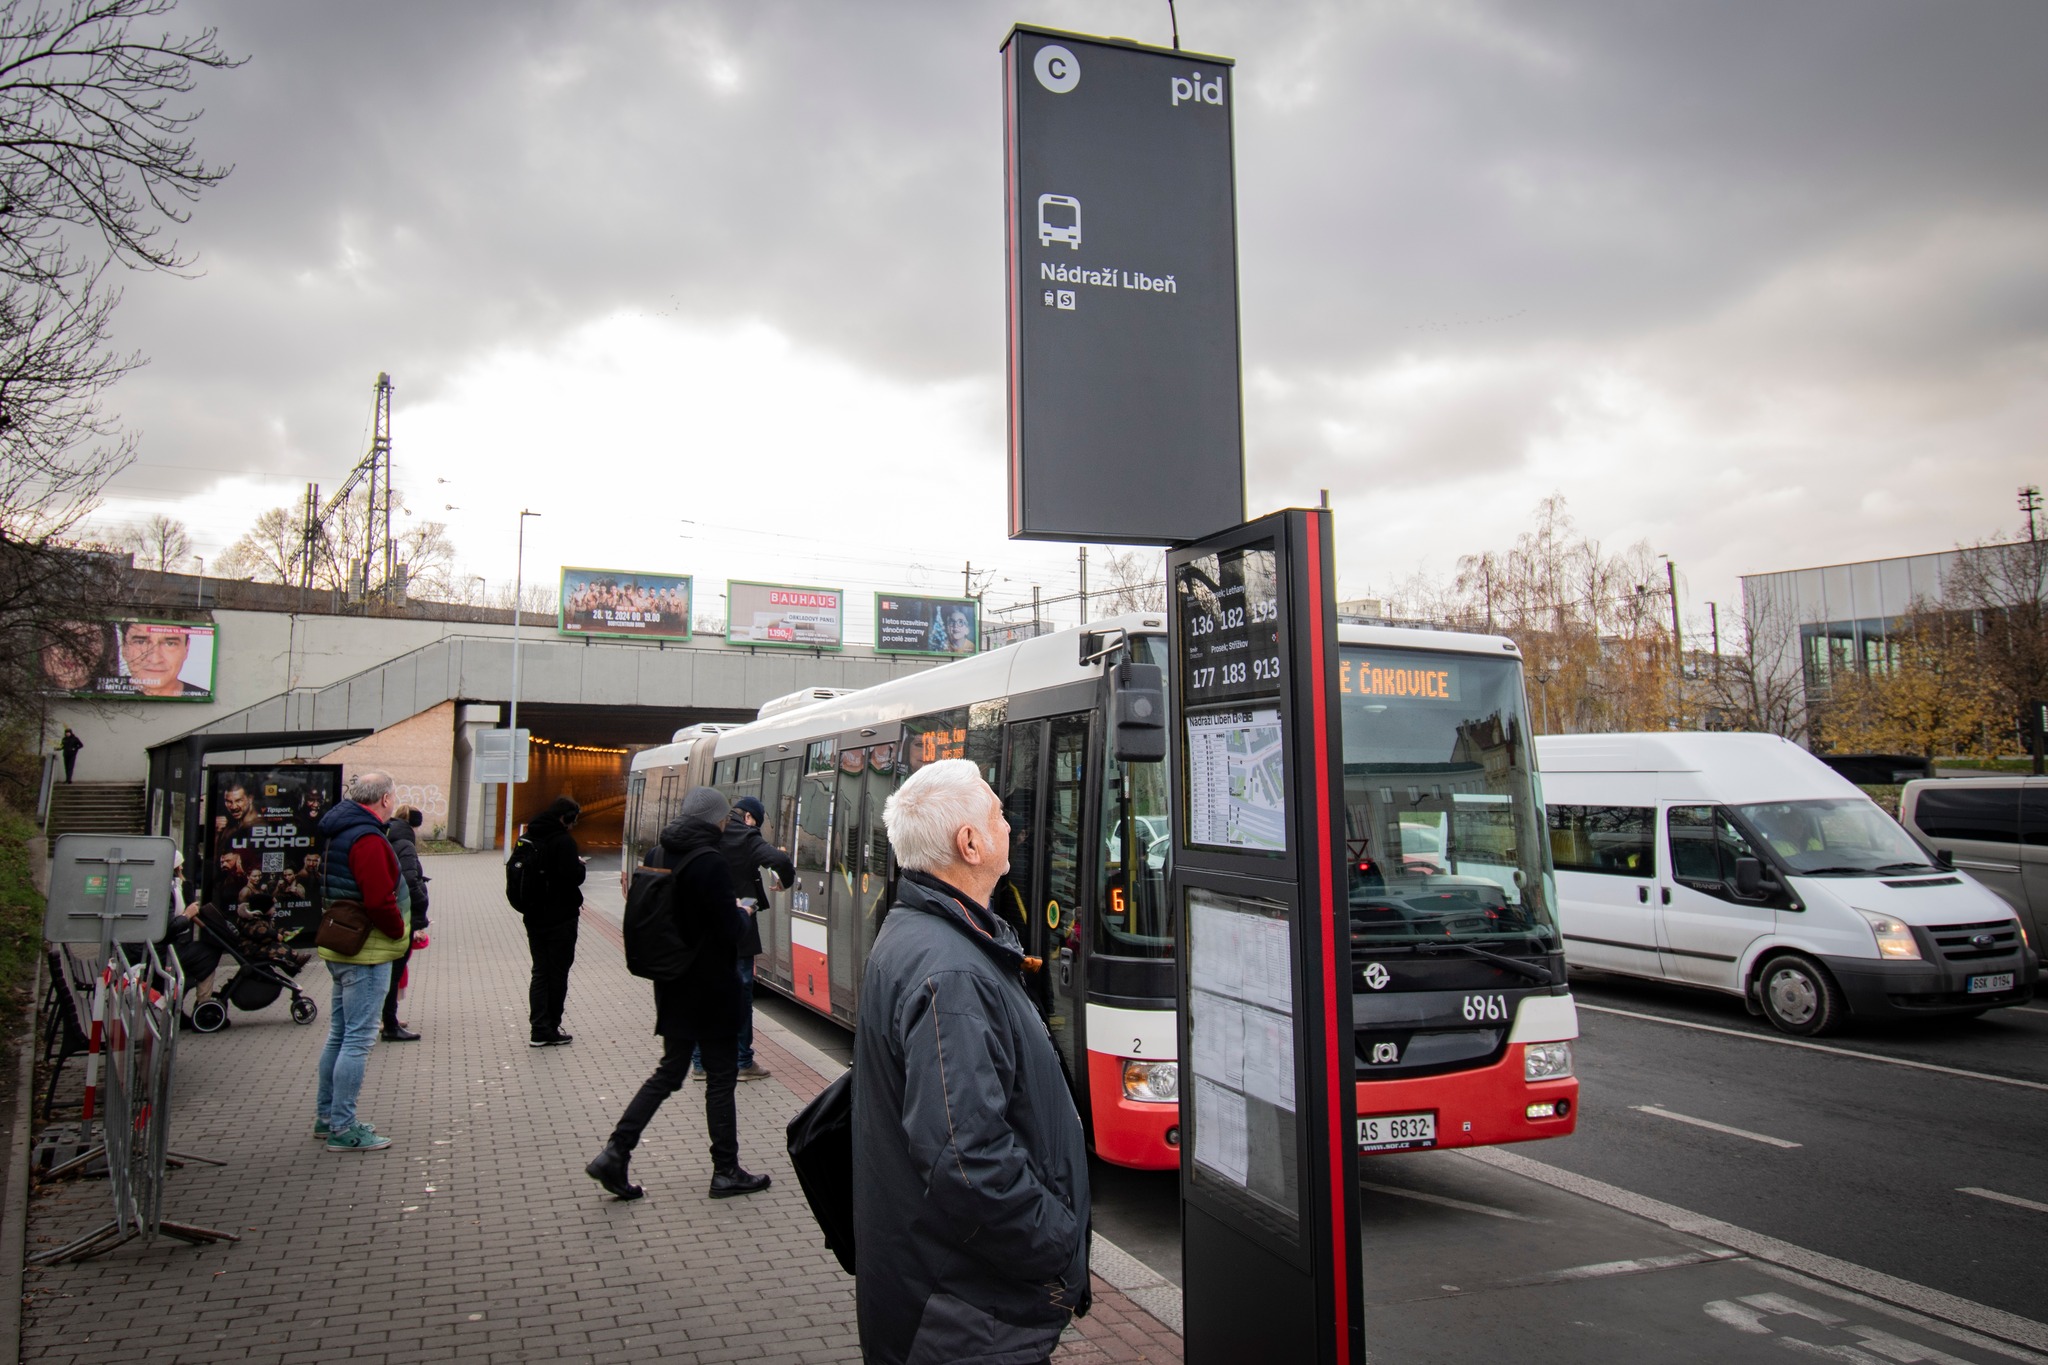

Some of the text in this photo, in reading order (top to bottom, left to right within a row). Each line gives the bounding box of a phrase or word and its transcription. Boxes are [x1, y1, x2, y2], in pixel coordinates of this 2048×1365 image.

[1048, 57, 1067, 80] C
[1171, 71, 1224, 106] pid
[1040, 262, 1177, 293] Nádraží Libeň
[771, 592, 836, 608] BAUHAUS
[614, 611, 630, 621] 2024
[899, 619, 929, 627] rozsvítíme
[1191, 598, 1278, 637] 136 182 195
[905, 628, 925, 636] stromy
[1193, 656, 1281, 689] 177 183 913
[1359, 662, 1449, 698] ČAKOVICE
[251, 823, 297, 837] BUĎ
[232, 836, 315, 849] U TOHO!
[1463, 994, 1508, 1021] 6961
[1132, 1038, 1142, 1054] 2
[1390, 1117, 1428, 1139] 6832
[1363, 1141, 1411, 1152] www.sor.cz
